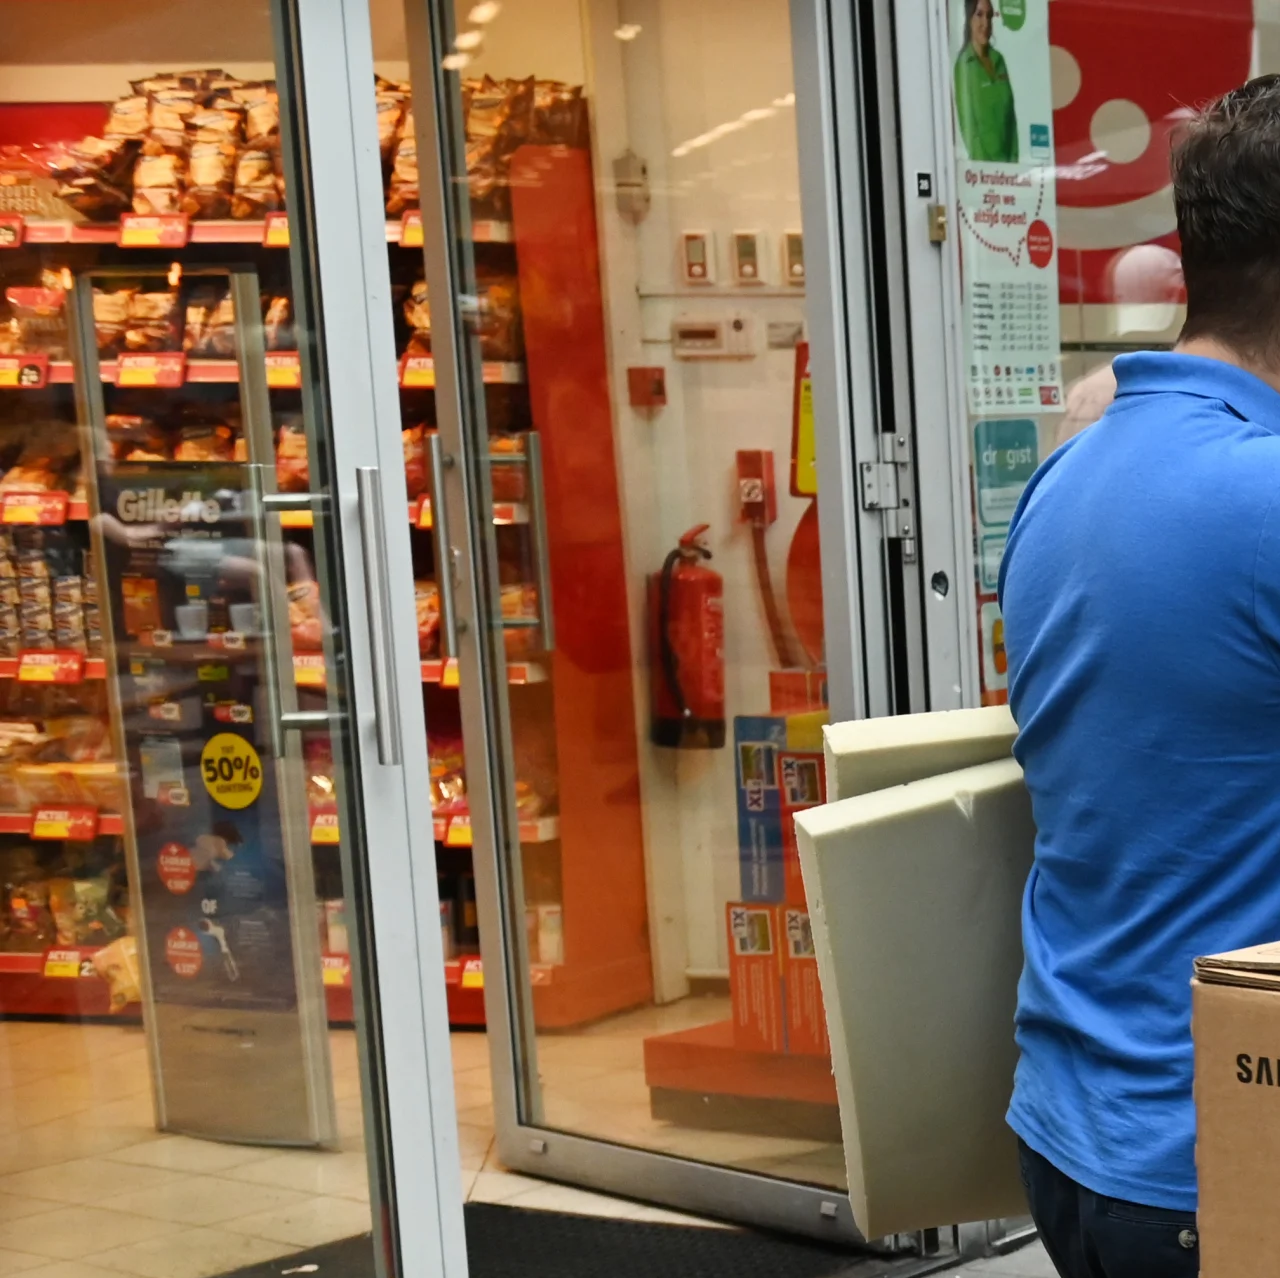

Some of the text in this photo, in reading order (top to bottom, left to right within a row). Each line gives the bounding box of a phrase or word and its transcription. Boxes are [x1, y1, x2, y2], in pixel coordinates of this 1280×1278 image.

[982, 441, 1031, 470] drgist
[117, 487, 221, 524] Gillette
[203, 755, 260, 783] 50%
[201, 898, 218, 915] OF
